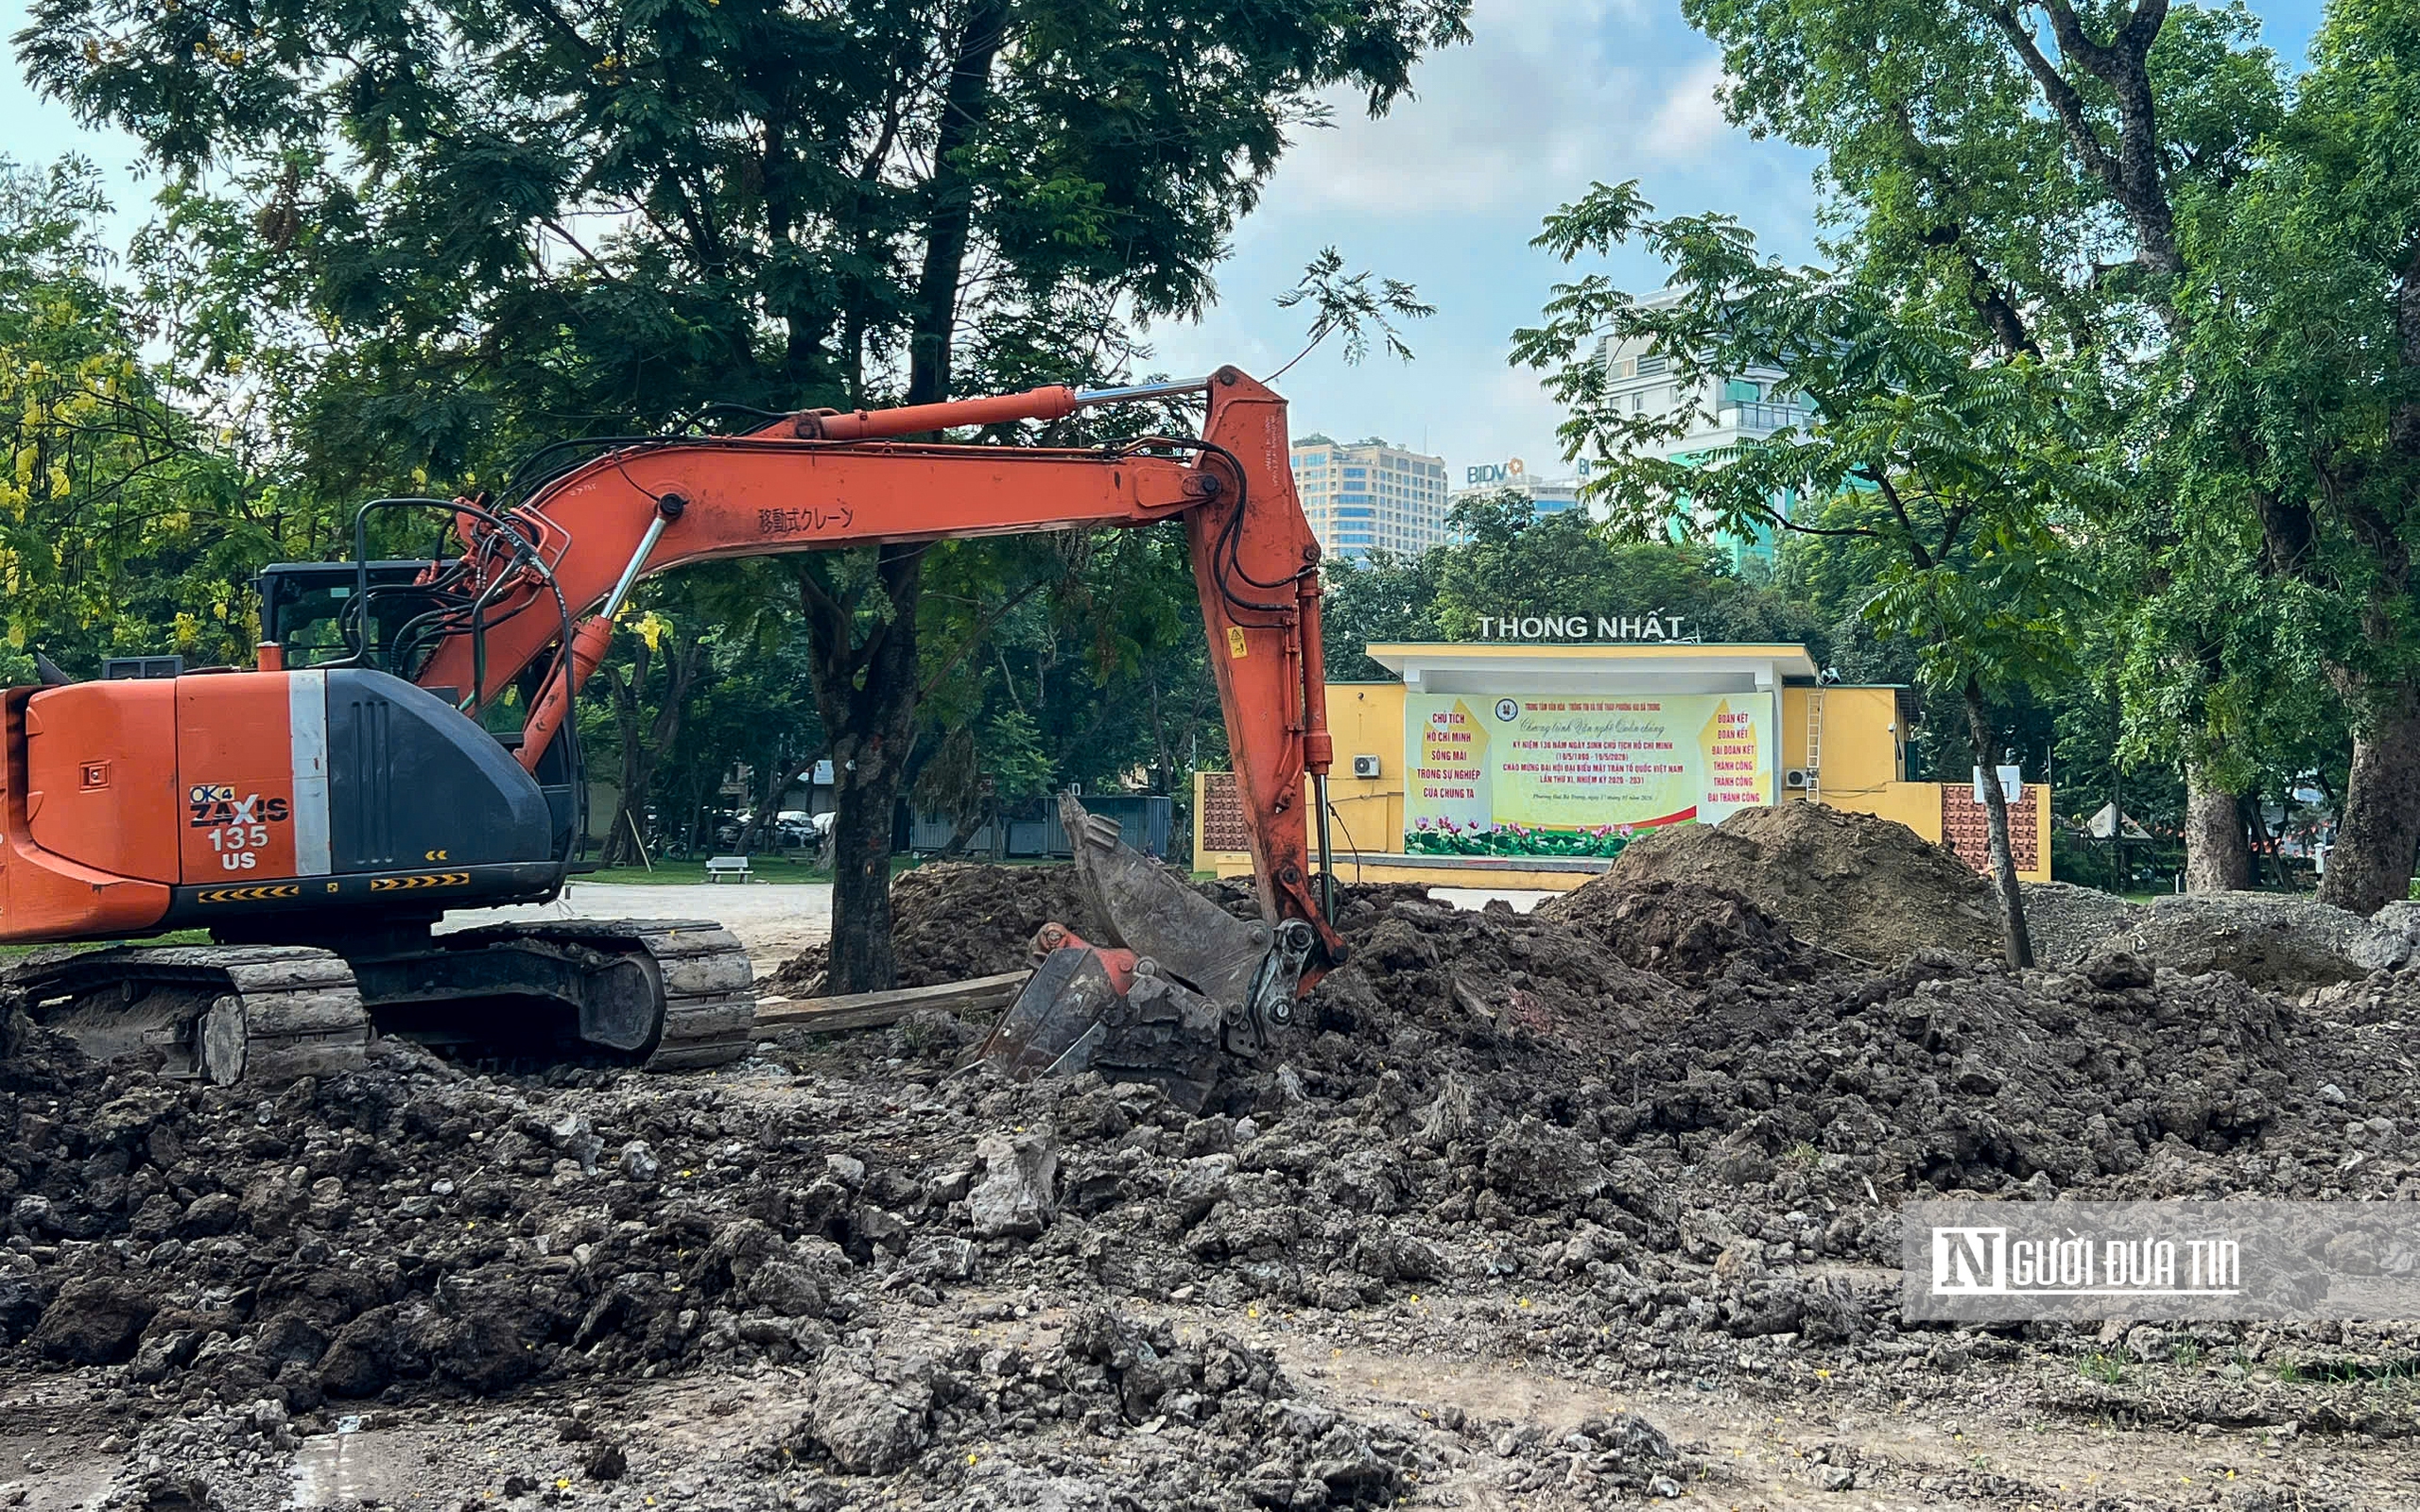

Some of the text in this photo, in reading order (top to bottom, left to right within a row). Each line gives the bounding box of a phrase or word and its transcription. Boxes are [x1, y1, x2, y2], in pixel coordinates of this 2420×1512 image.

[1467, 463, 1508, 484] BIDV
[757, 507, 854, 534] 移動式クレーン
[1597, 607, 1685, 639] NHẤT
[190, 794, 289, 828] ZAXIS
[208, 826, 268, 851] 135
[222, 851, 257, 870] US
